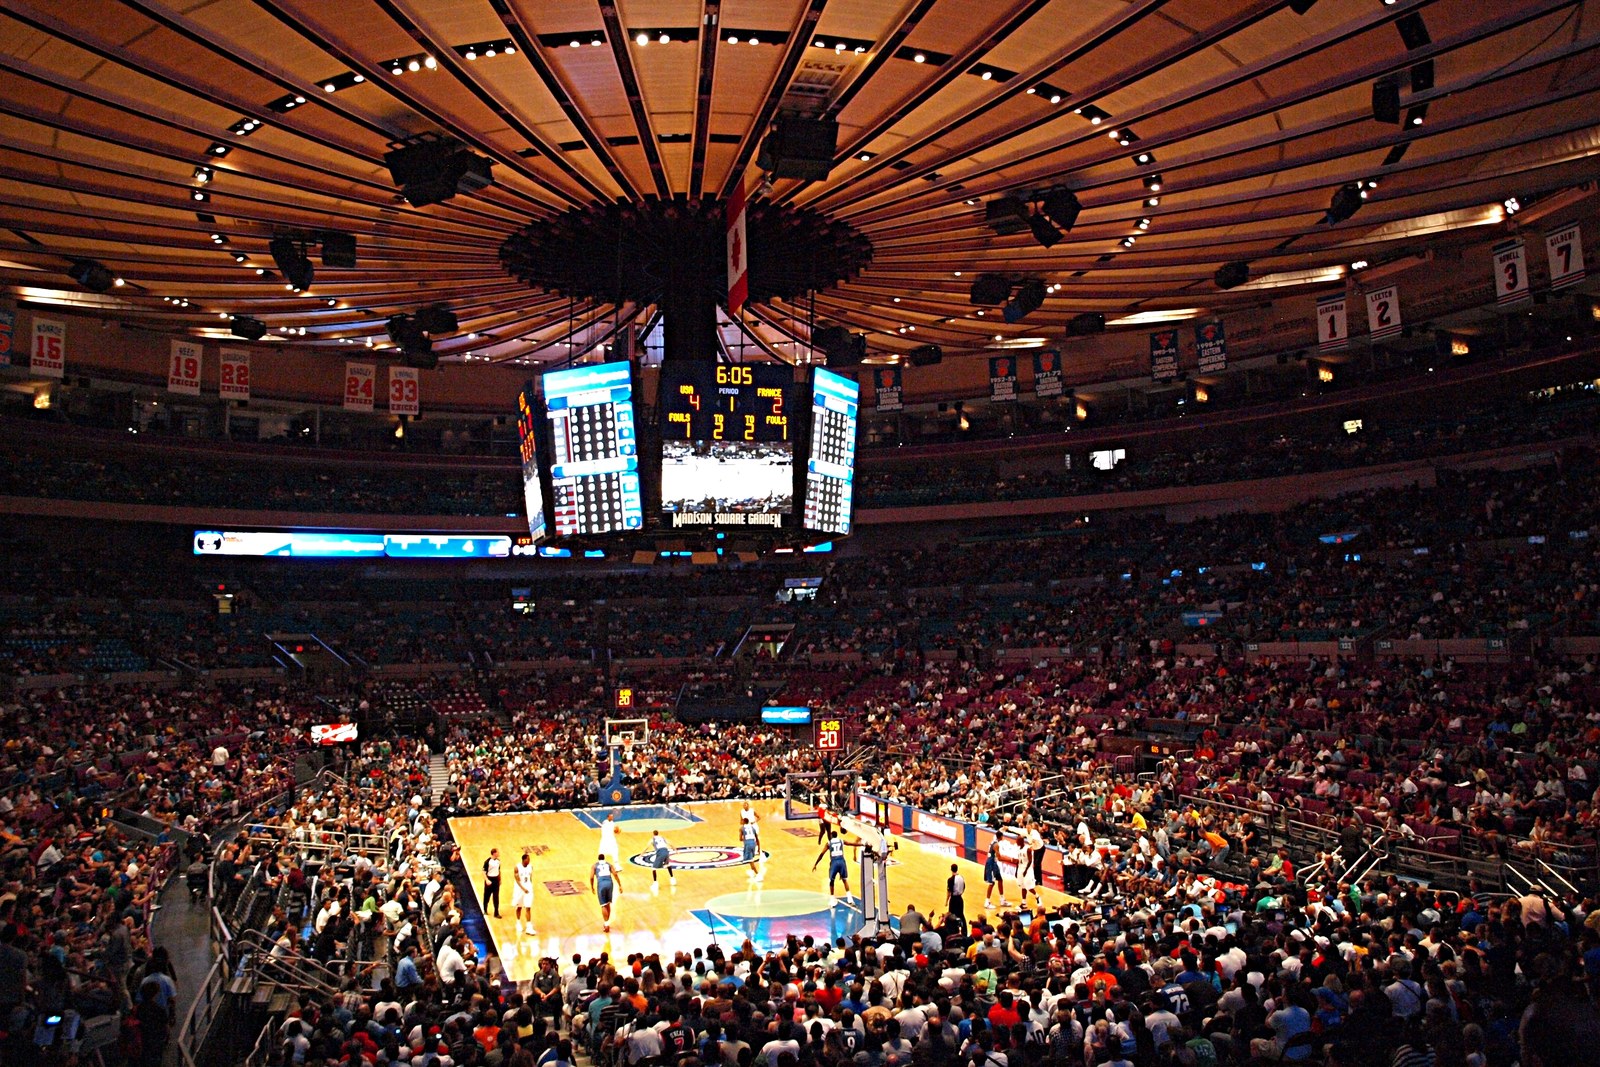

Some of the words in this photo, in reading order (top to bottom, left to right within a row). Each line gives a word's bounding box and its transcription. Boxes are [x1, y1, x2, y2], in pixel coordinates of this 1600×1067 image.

[1550, 231, 1576, 247] GILBERT
[1557, 243, 1571, 273] 7
[1504, 262, 1518, 290] 3
[1376, 300, 1391, 327] 2
[1328, 314, 1337, 338] 1
[36, 335, 62, 360] 15
[32, 358, 63, 369] KNICKS
[172, 355, 198, 379] 19
[221, 363, 249, 385] 22
[716, 366, 752, 384] 6:05
[170, 377, 199, 388] KNICKS
[221, 384, 249, 394] KNICKS
[346, 376, 373, 397] 24
[391, 379, 418, 402] 33
[680, 385, 694, 394] USA
[757, 388, 782, 396] FRANCE
[345, 396, 373, 405] KNICKS
[391, 404, 418, 412] KNICKS
[690, 395, 700, 410] 4
[730, 396, 734, 412] 1
[772, 397, 782, 414] 2
[668, 412, 690, 422] FOULS
[713, 414, 724, 424] TO
[744, 415, 755, 424] TO
[766, 416, 787, 425] FOULS
[686, 422, 690, 438] 1
[713, 423, 724, 440] 2
[744, 424, 754, 440] 2
[783, 424, 787, 440] 1
[672, 512, 712, 528] MADISON
[714, 512, 746, 524] SQUARE
[748, 512, 782, 528] GARDEN
[820, 720, 840, 731] 6:05
[820, 731, 838, 748] 20
[1170, 993, 1190, 1014] 72
[674, 1036, 684, 1052] 7
